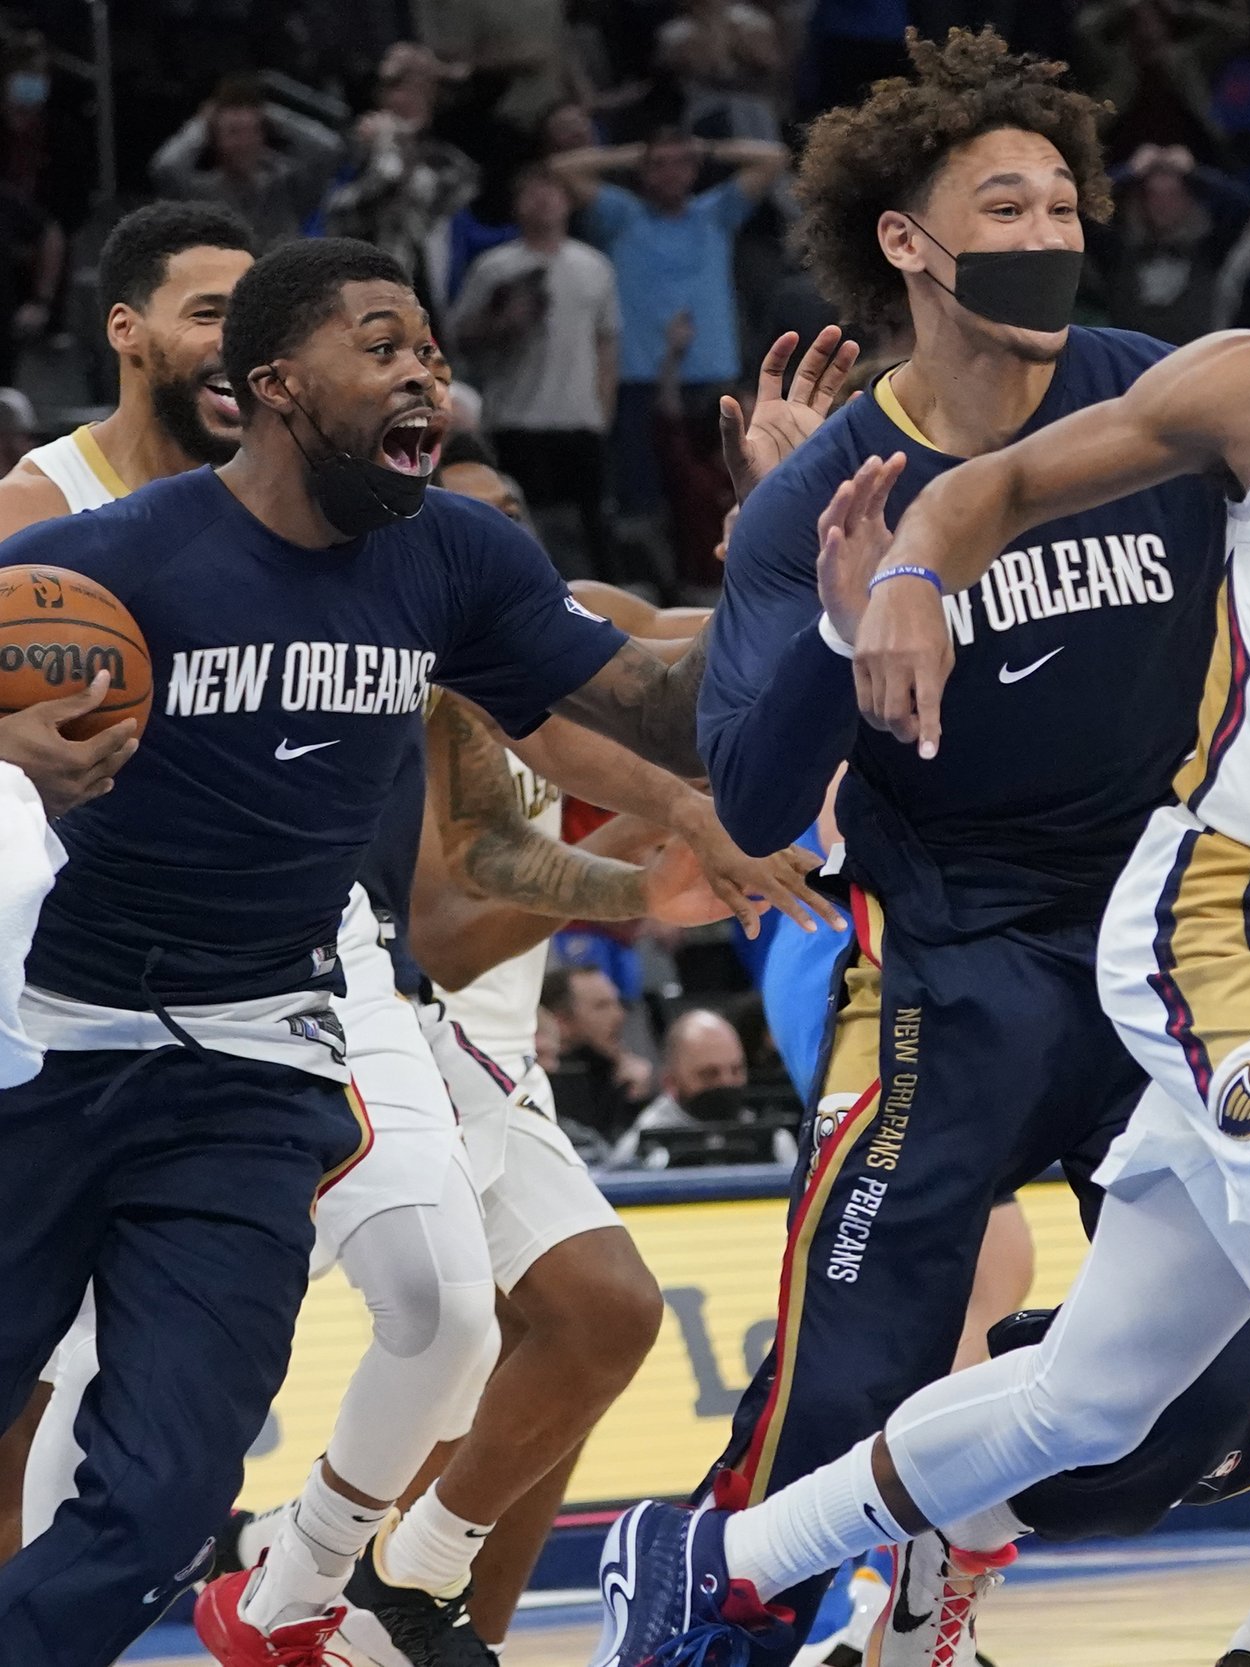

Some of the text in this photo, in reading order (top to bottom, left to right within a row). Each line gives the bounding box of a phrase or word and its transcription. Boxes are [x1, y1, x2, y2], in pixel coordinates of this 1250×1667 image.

[980, 533, 1175, 632] ORLEANS
[0, 641, 127, 690] Wilso
[165, 641, 436, 717] NEW ORLEANS
[826, 1006, 922, 1284] NEW ORLEANS PELICANS
